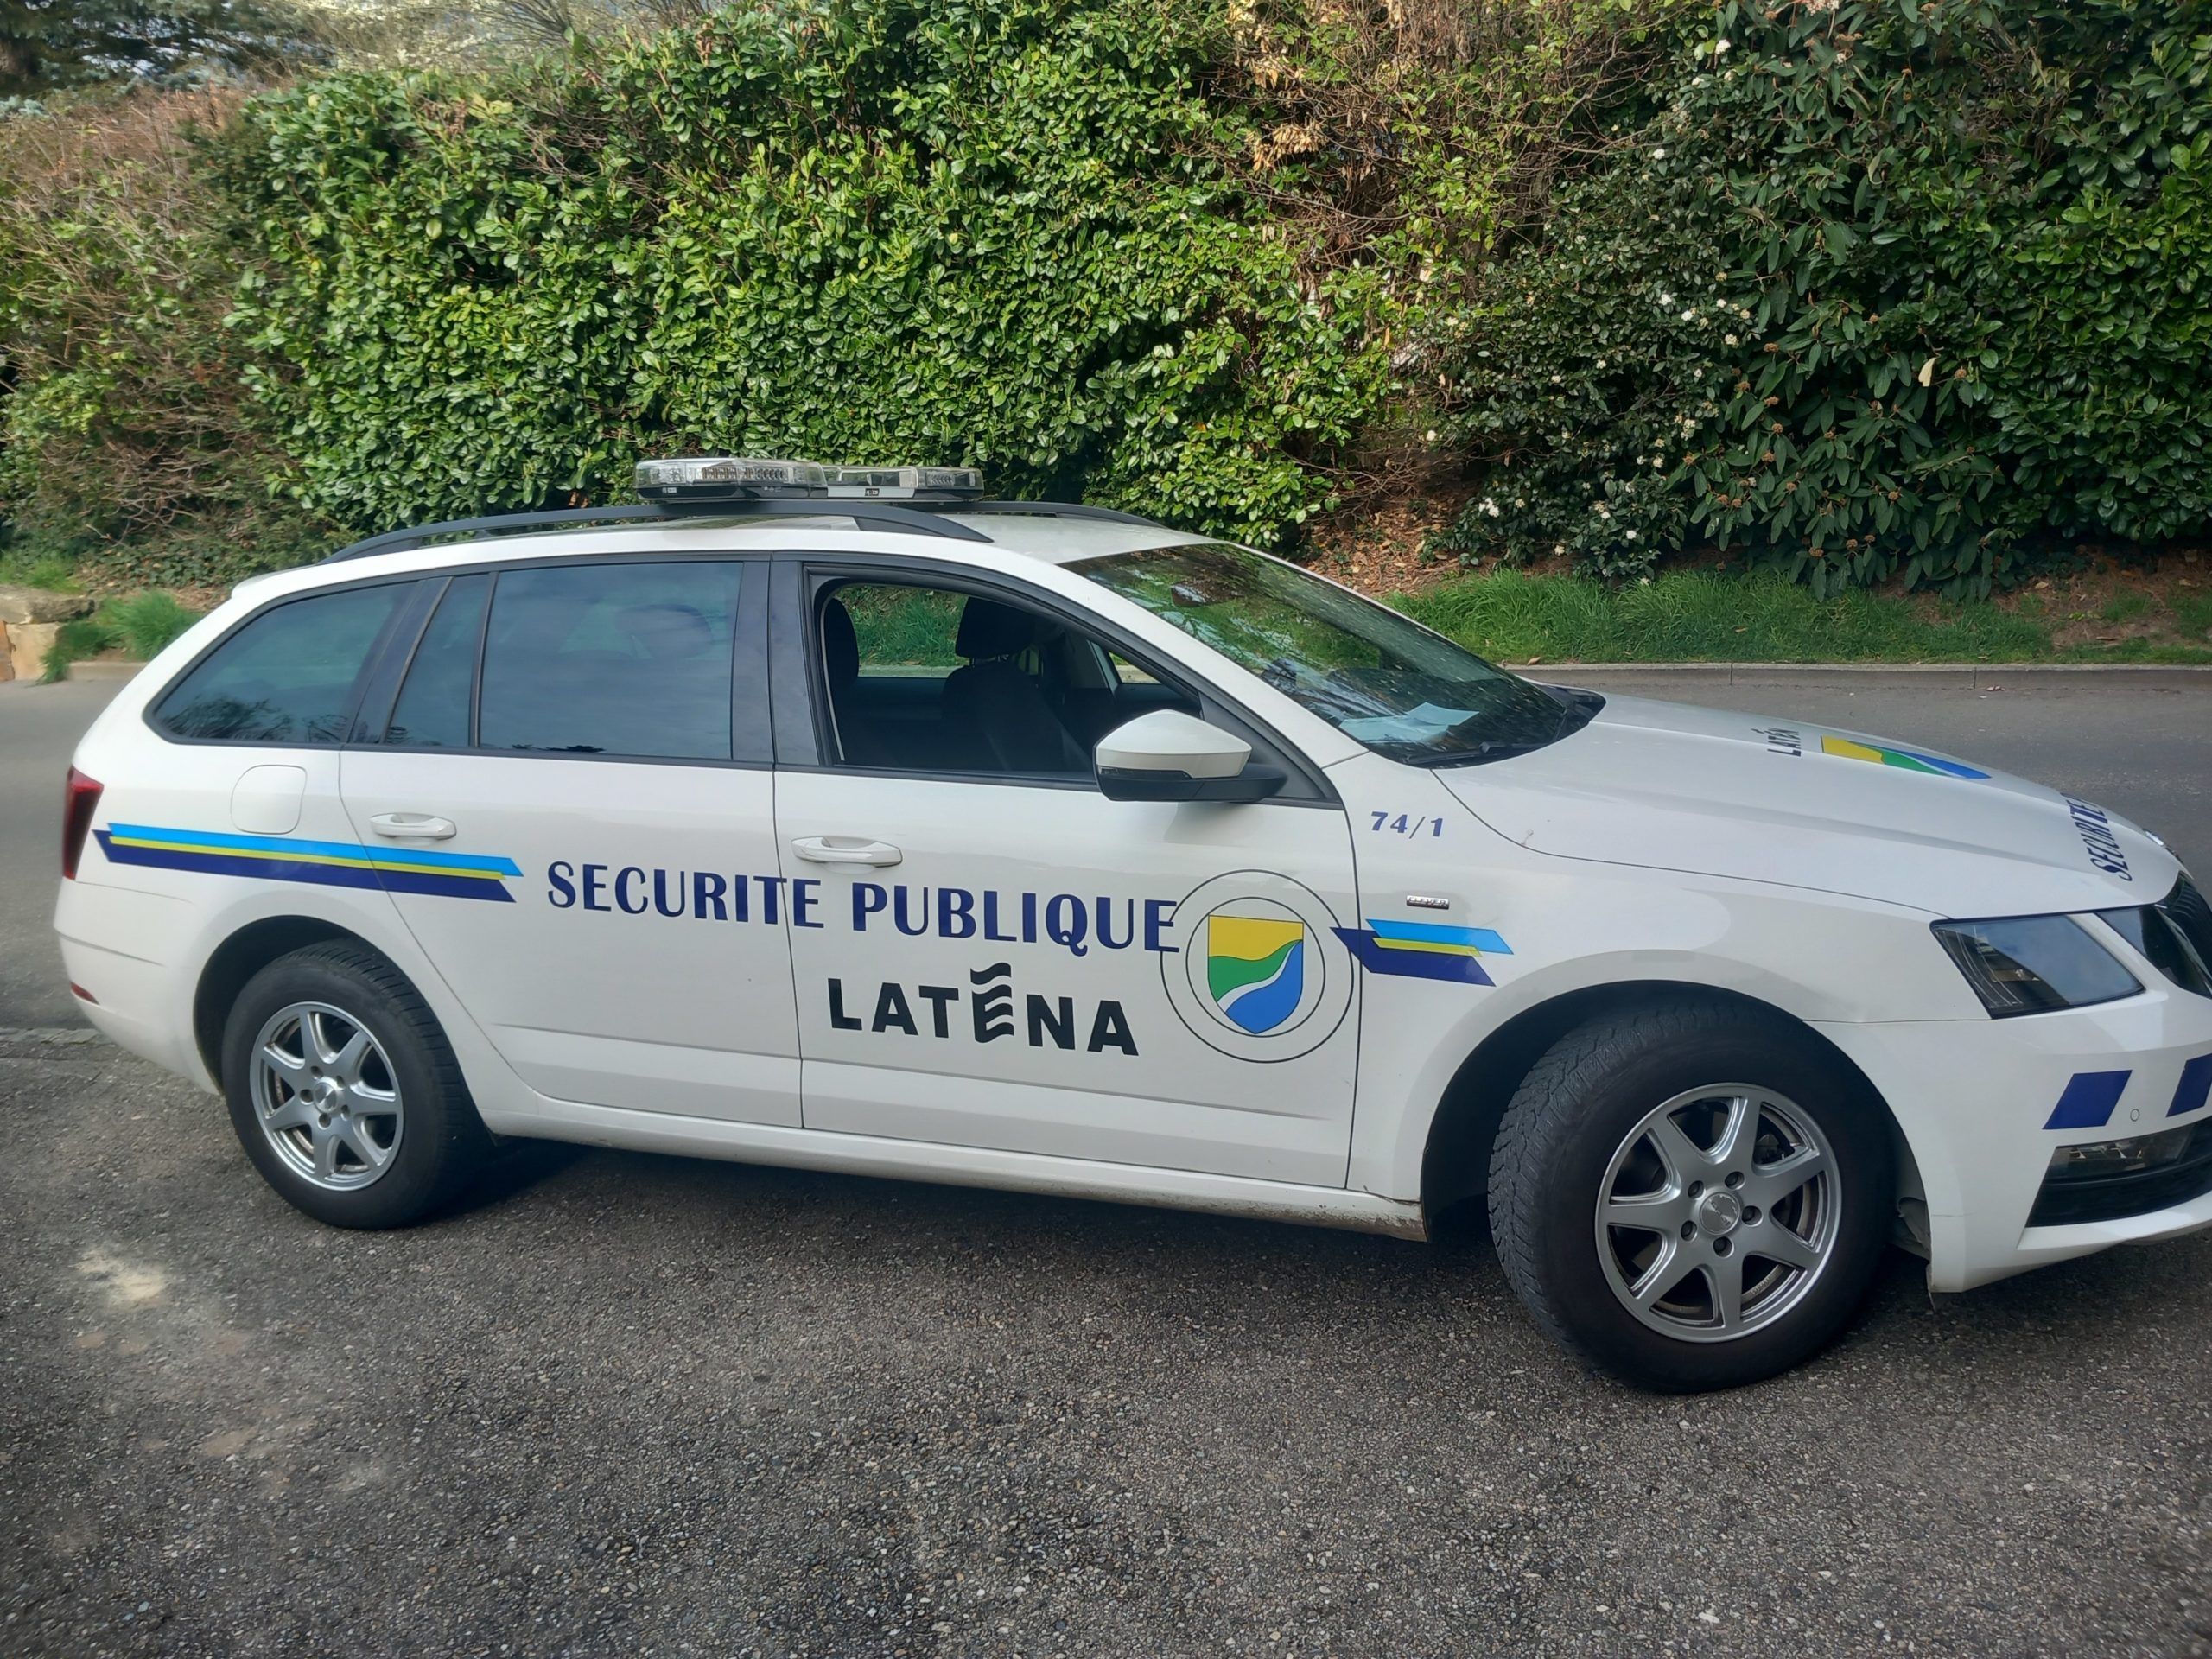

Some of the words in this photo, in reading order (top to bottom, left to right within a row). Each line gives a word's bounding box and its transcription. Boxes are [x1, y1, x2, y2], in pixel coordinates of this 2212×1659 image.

[1370, 810, 1444, 839] 74/1
[2065, 799, 2133, 882] SECURITE
[547, 861, 824, 929] SECURITE
[851, 882, 1180, 957] PUBLIQUE
